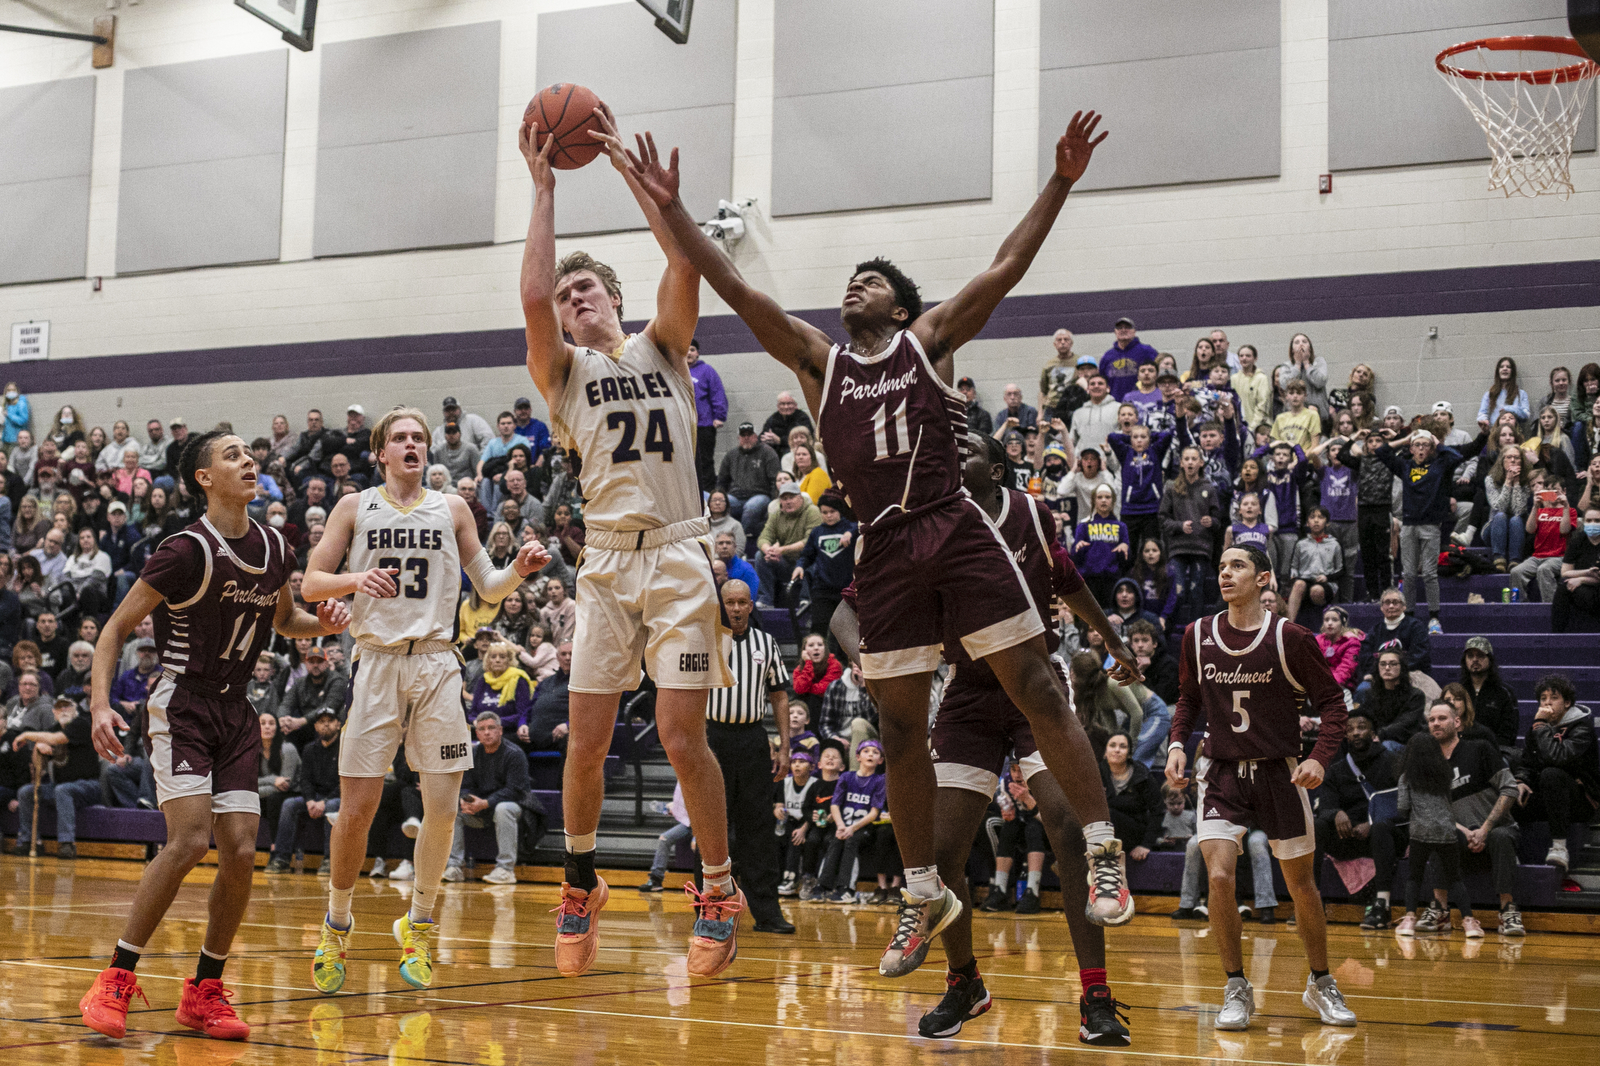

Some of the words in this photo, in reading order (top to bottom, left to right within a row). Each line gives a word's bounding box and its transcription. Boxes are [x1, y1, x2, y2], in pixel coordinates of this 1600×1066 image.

[20, 327, 41, 335] VISITOR
[20, 337, 39, 345] PARENT
[19, 347, 40, 355] SECTION
[585, 371, 673, 407] EAGLES
[840, 363, 918, 405] Parchment
[606, 408, 675, 464] 24
[870, 397, 912, 461] 11
[367, 528, 442, 550] EAGLES
[1088, 523, 1120, 536] NICE
[378, 556, 429, 599] 33
[219, 612, 261, 661] 14
[679, 652, 709, 672] EAGLES
[1203, 663, 1273, 684] Parchment
[1231, 690, 1251, 733] 5
[440, 742, 468, 760] EAGLES
[846, 792, 870, 804] EAGLES
